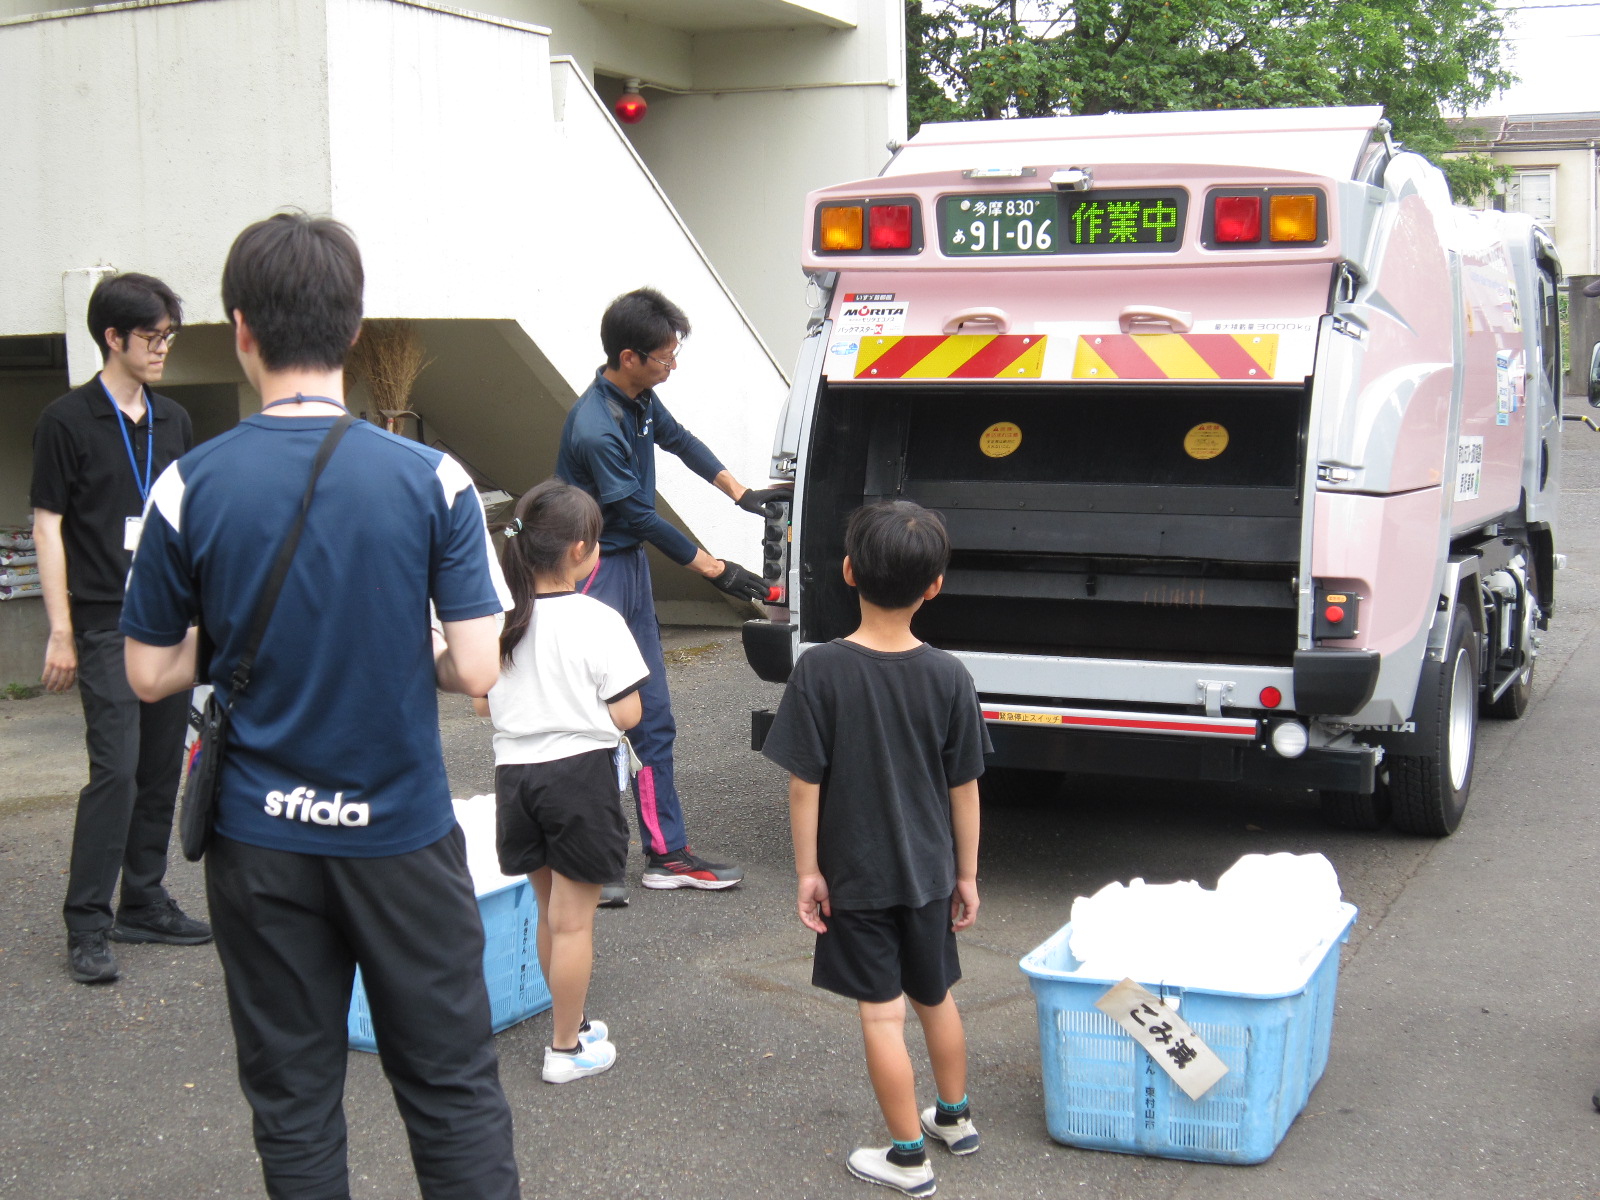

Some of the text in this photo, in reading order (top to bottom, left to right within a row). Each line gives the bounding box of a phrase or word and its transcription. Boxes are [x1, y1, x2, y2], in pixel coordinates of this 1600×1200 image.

[972, 200, 1034, 217] 多摩 830
[1072, 201, 1176, 243] 作業中
[952, 219, 1052, 251] あ 91-06
[843, 305, 904, 316] MORITA
[999, 711, 1061, 724] 緊急停止スイッチ
[263, 786, 370, 827] sfida
